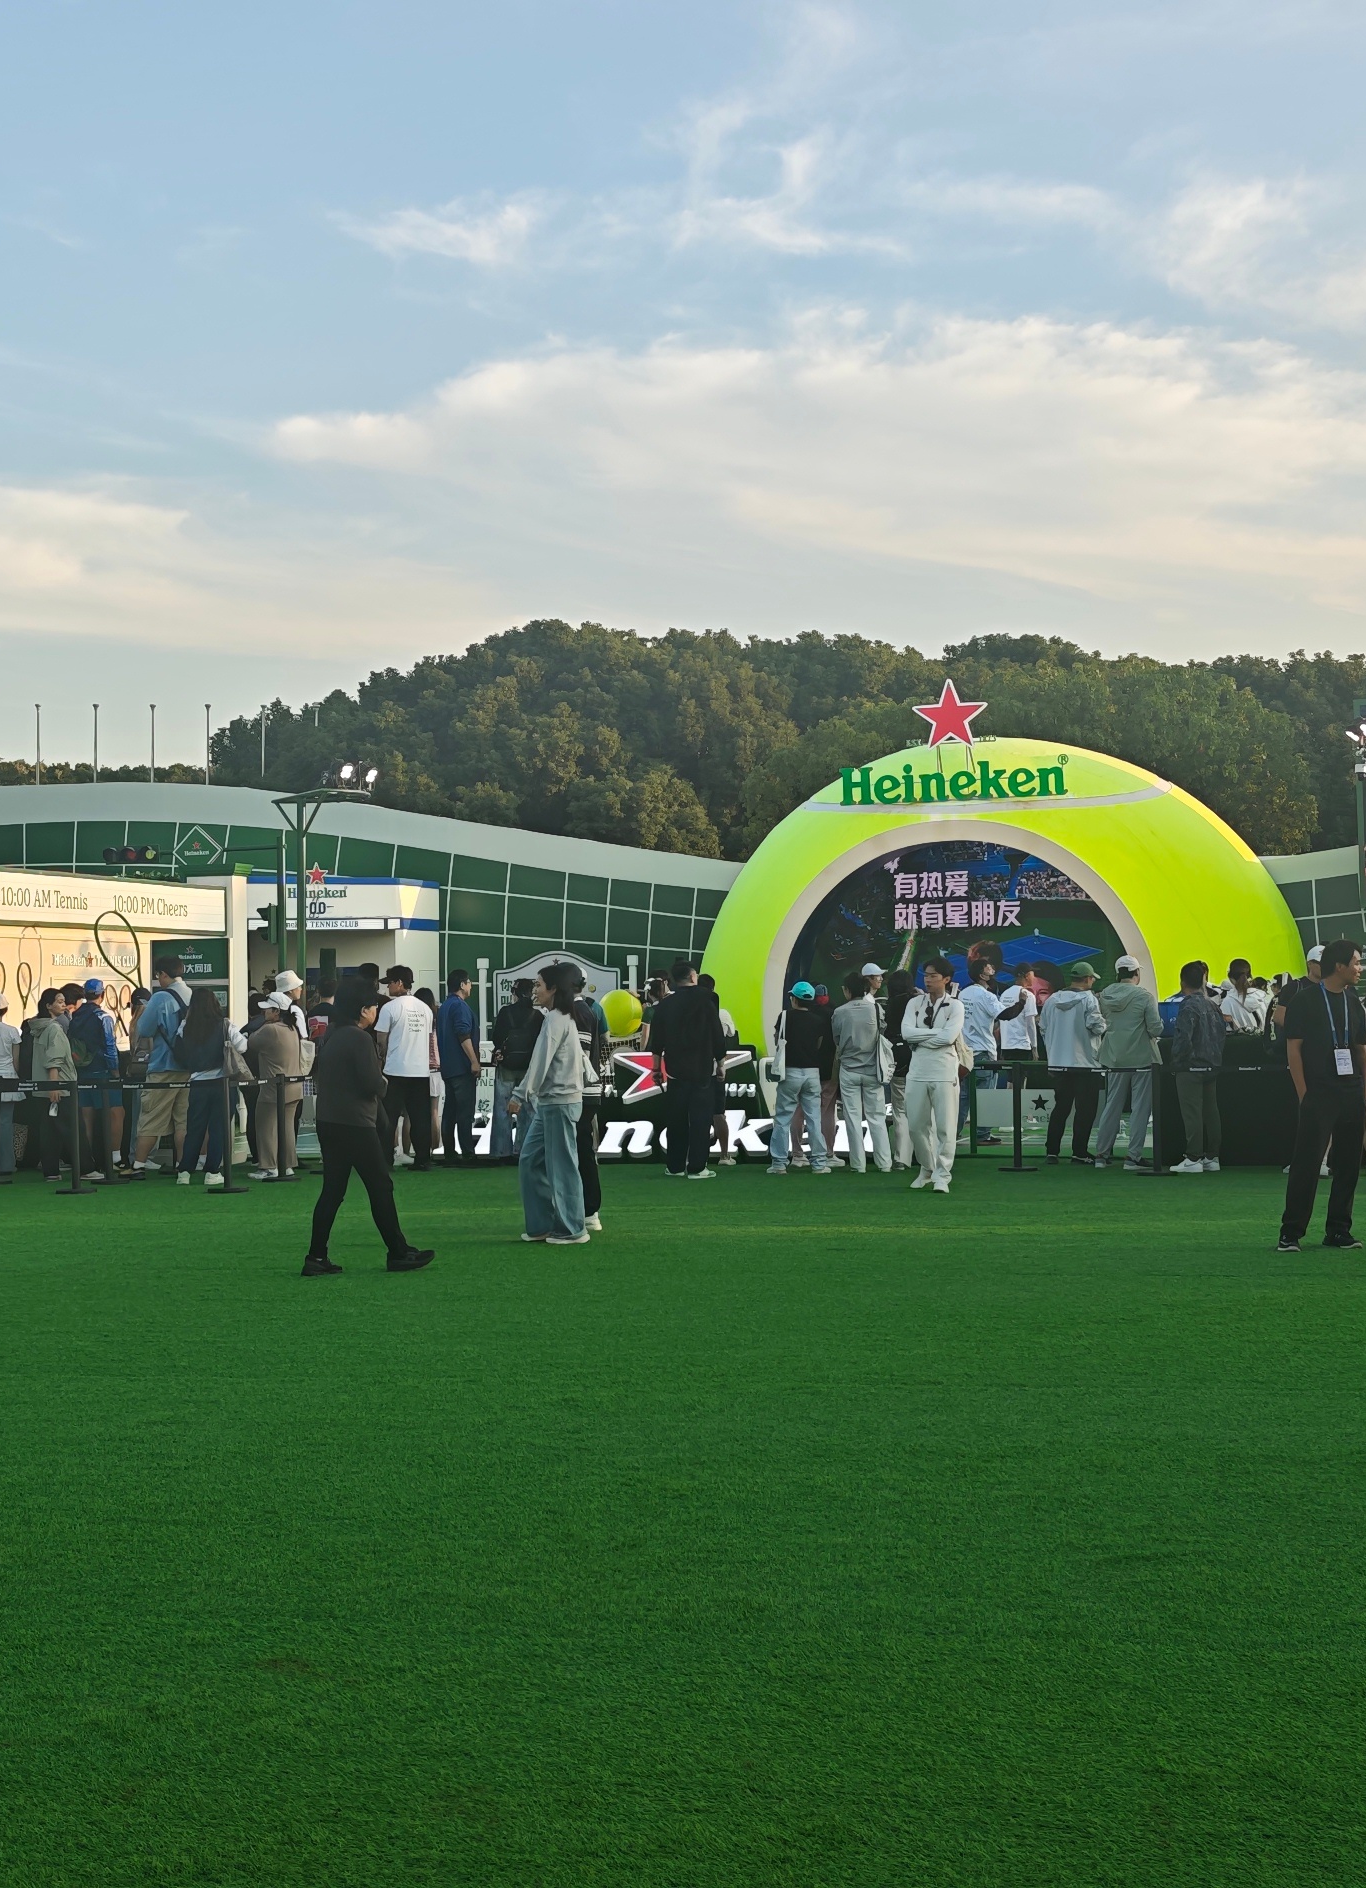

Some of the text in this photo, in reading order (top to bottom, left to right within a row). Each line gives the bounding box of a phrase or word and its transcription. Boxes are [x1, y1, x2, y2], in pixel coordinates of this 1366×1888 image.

[839, 760, 1068, 806] Heineken
[287, 887, 347, 899] Hineken
[893, 870, 969, 899] 有热爱
[1, 886, 188, 918] 10:00 AM Tennis 10:00 PM Cheers
[894, 900, 1022, 930] 就有星朋友
[340, 920, 359, 928] CLUB
